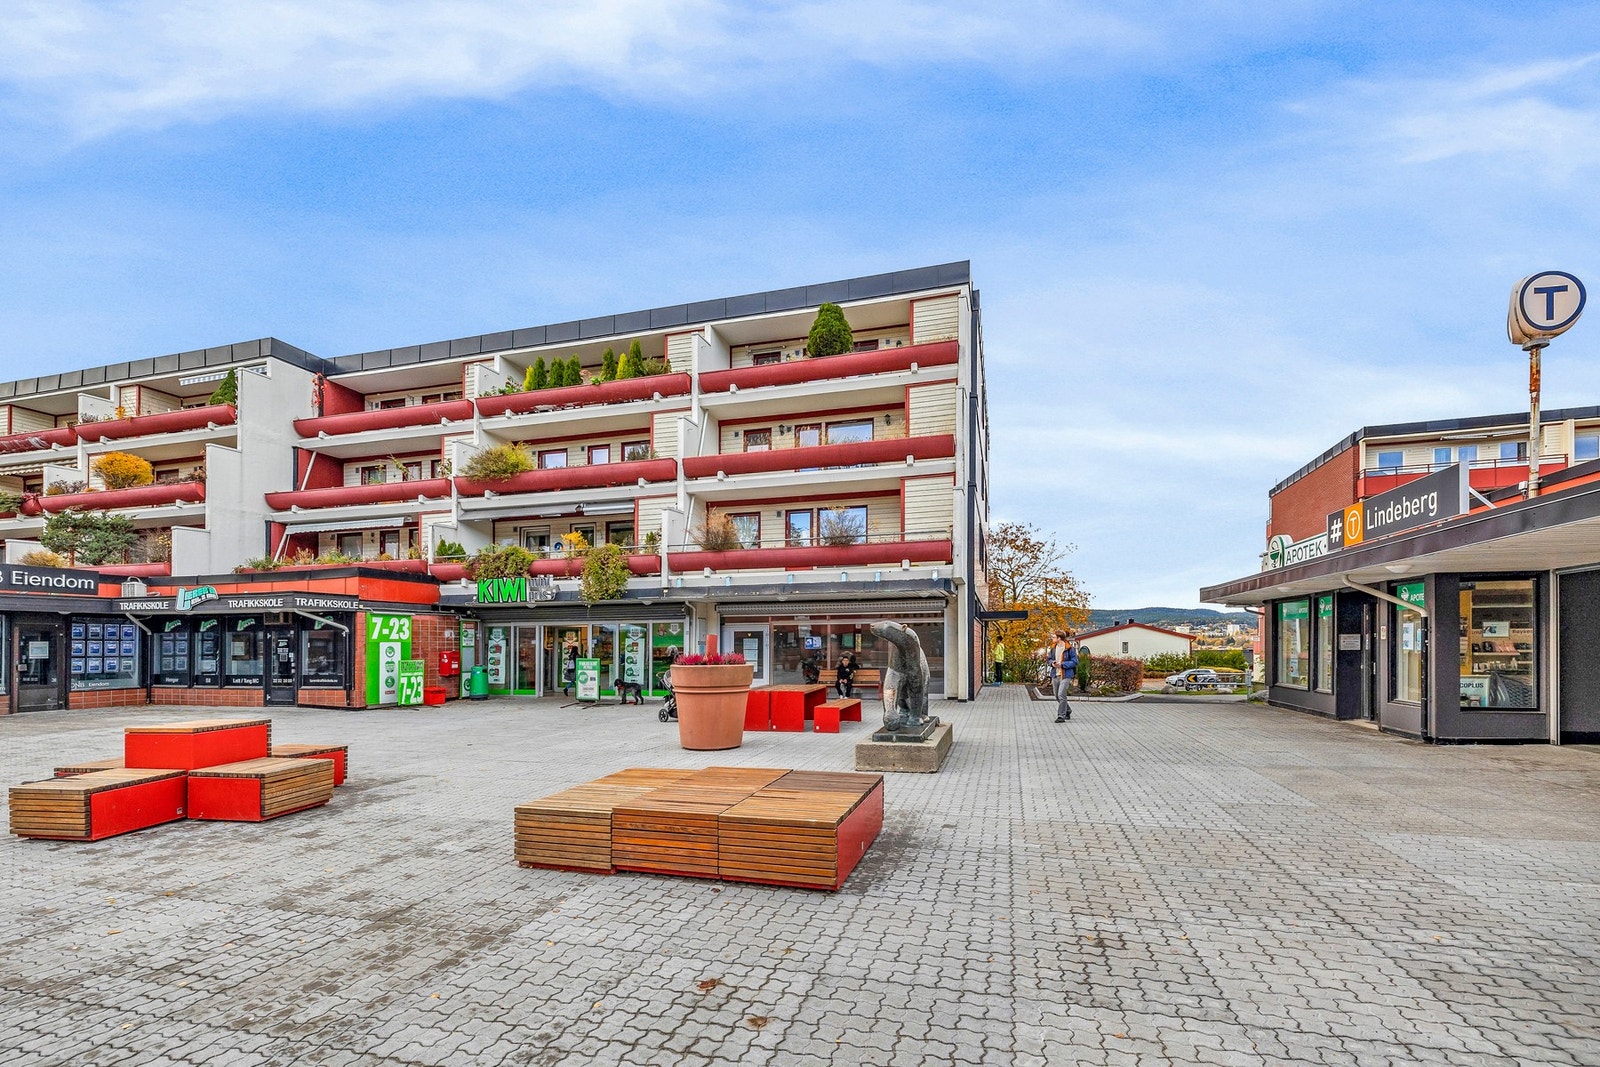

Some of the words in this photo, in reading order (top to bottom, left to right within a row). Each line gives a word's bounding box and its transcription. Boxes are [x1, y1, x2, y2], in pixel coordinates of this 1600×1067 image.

[1534, 285, 1568, 320] T
[1367, 491, 1437, 530] Lindeberg
[1286, 541, 1322, 564] APOTEK
[12, 571, 94, 589] Eiendom
[478, 577, 527, 603] KIWI
[119, 601, 169, 610] TRAFIKKSKOLE
[228, 598, 283, 608] TRAFIKKSKOLE
[294, 597, 358, 609] TRAFIKKSKOLE
[371, 617, 410, 640] 7-23
[400, 676, 424, 704] 7-23
